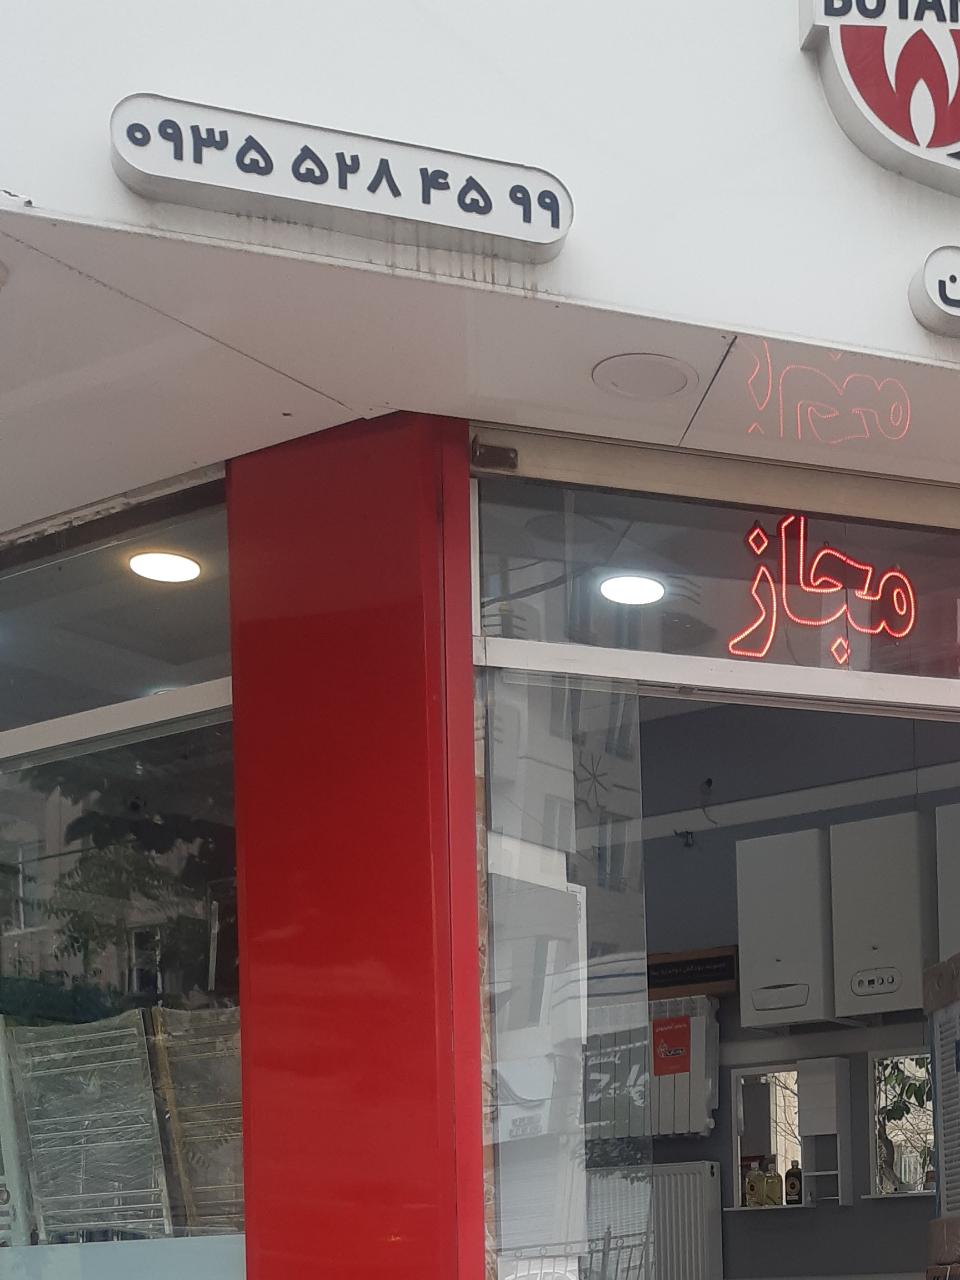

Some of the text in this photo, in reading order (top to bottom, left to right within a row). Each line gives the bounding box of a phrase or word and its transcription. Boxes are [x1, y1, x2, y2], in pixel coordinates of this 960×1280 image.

[126, 118, 560, 229] ۰۹۳۵ ۵۲۸ ۴۵ ۹۹
[729, 515, 916, 664] مجاز
